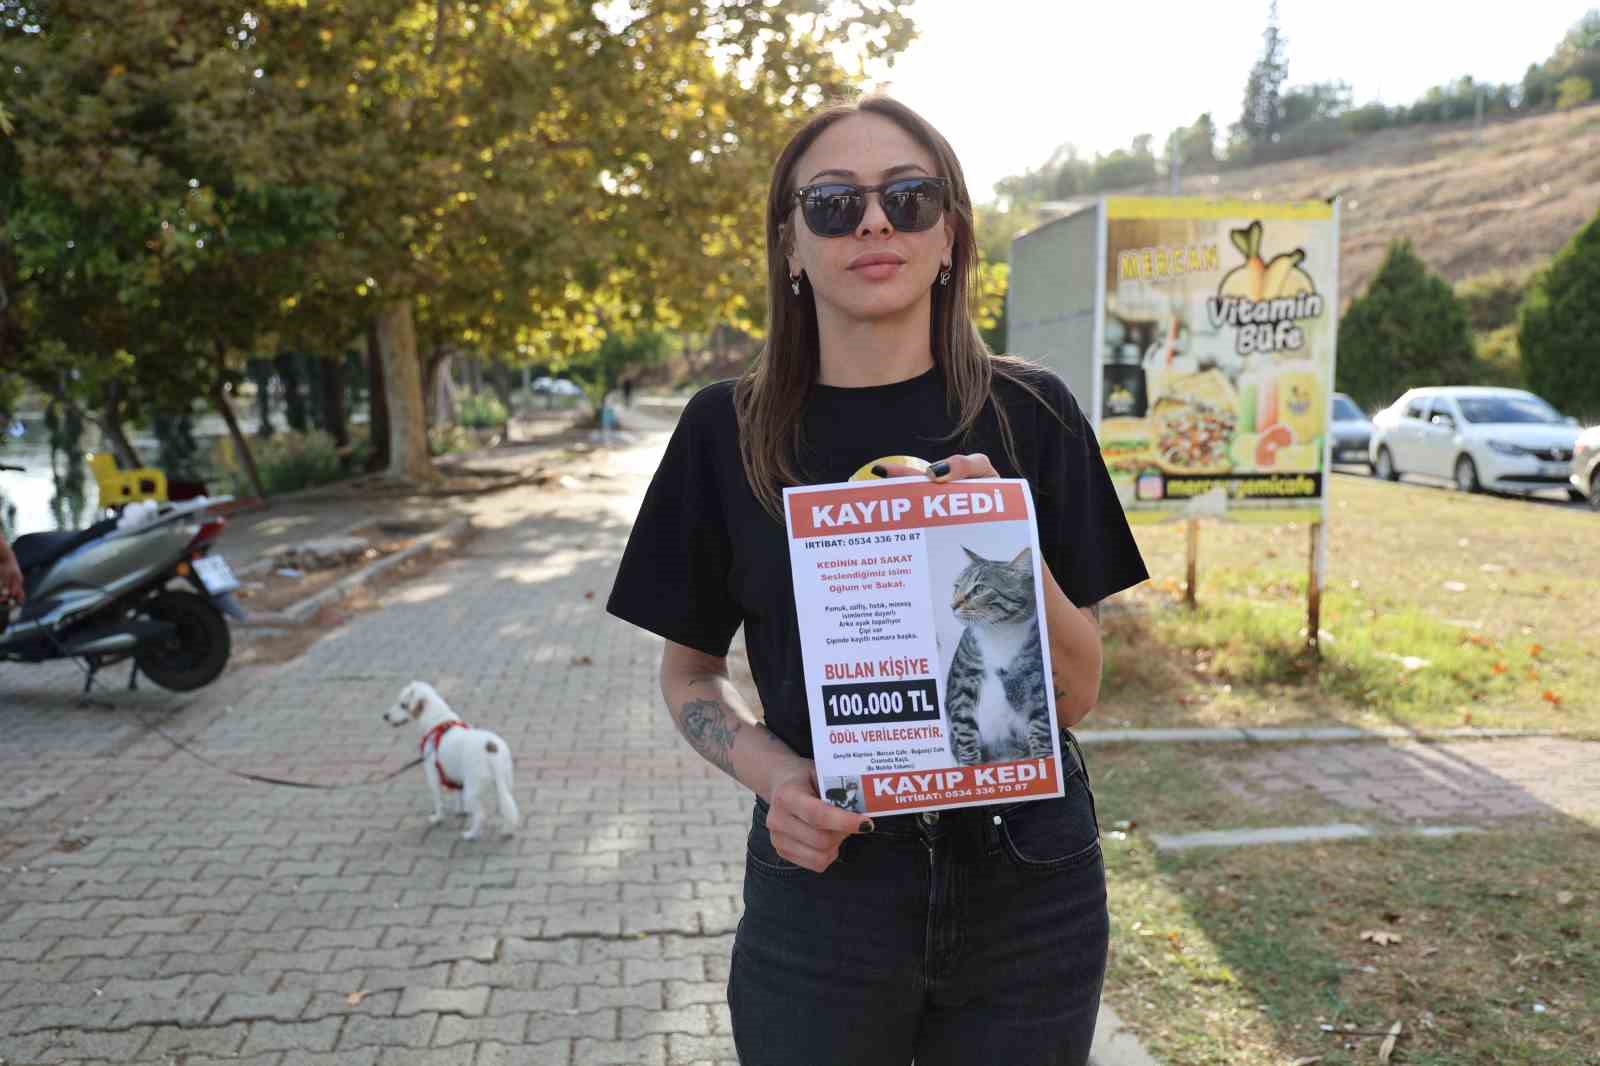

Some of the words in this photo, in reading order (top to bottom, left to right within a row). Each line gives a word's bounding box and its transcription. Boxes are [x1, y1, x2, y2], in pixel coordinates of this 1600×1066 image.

[1206, 291, 1325, 329] Vitamin
[1235, 320, 1305, 356] Büfe
[812, 498, 911, 529] KAYIP
[923, 489, 1005, 518] KEDİ
[805, 538, 846, 549] İRTİBAT:
[848, 535, 871, 546] 0534
[875, 534, 892, 544] 336
[895, 533, 906, 543] 70
[909, 532, 920, 541] 87
[861, 557, 877, 566] ADI
[880, 554, 913, 564] SAKAT
[862, 583, 873, 591] ve
[824, 661, 875, 680] BULAN
[879, 655, 930, 681] KİŞİYE
[828, 690, 904, 717] 100.000
[907, 689, 935, 713] TL
[829, 731, 860, 745] ÖDÜL
[861, 725, 944, 742] VERİLECEKTİR.
[873, 770, 964, 797] KAYIP
[975, 757, 1049, 787] KEDİ
[945, 789, 972, 799] 0534
[976, 787, 994, 796] 336
[998, 785, 1011, 793] 70
